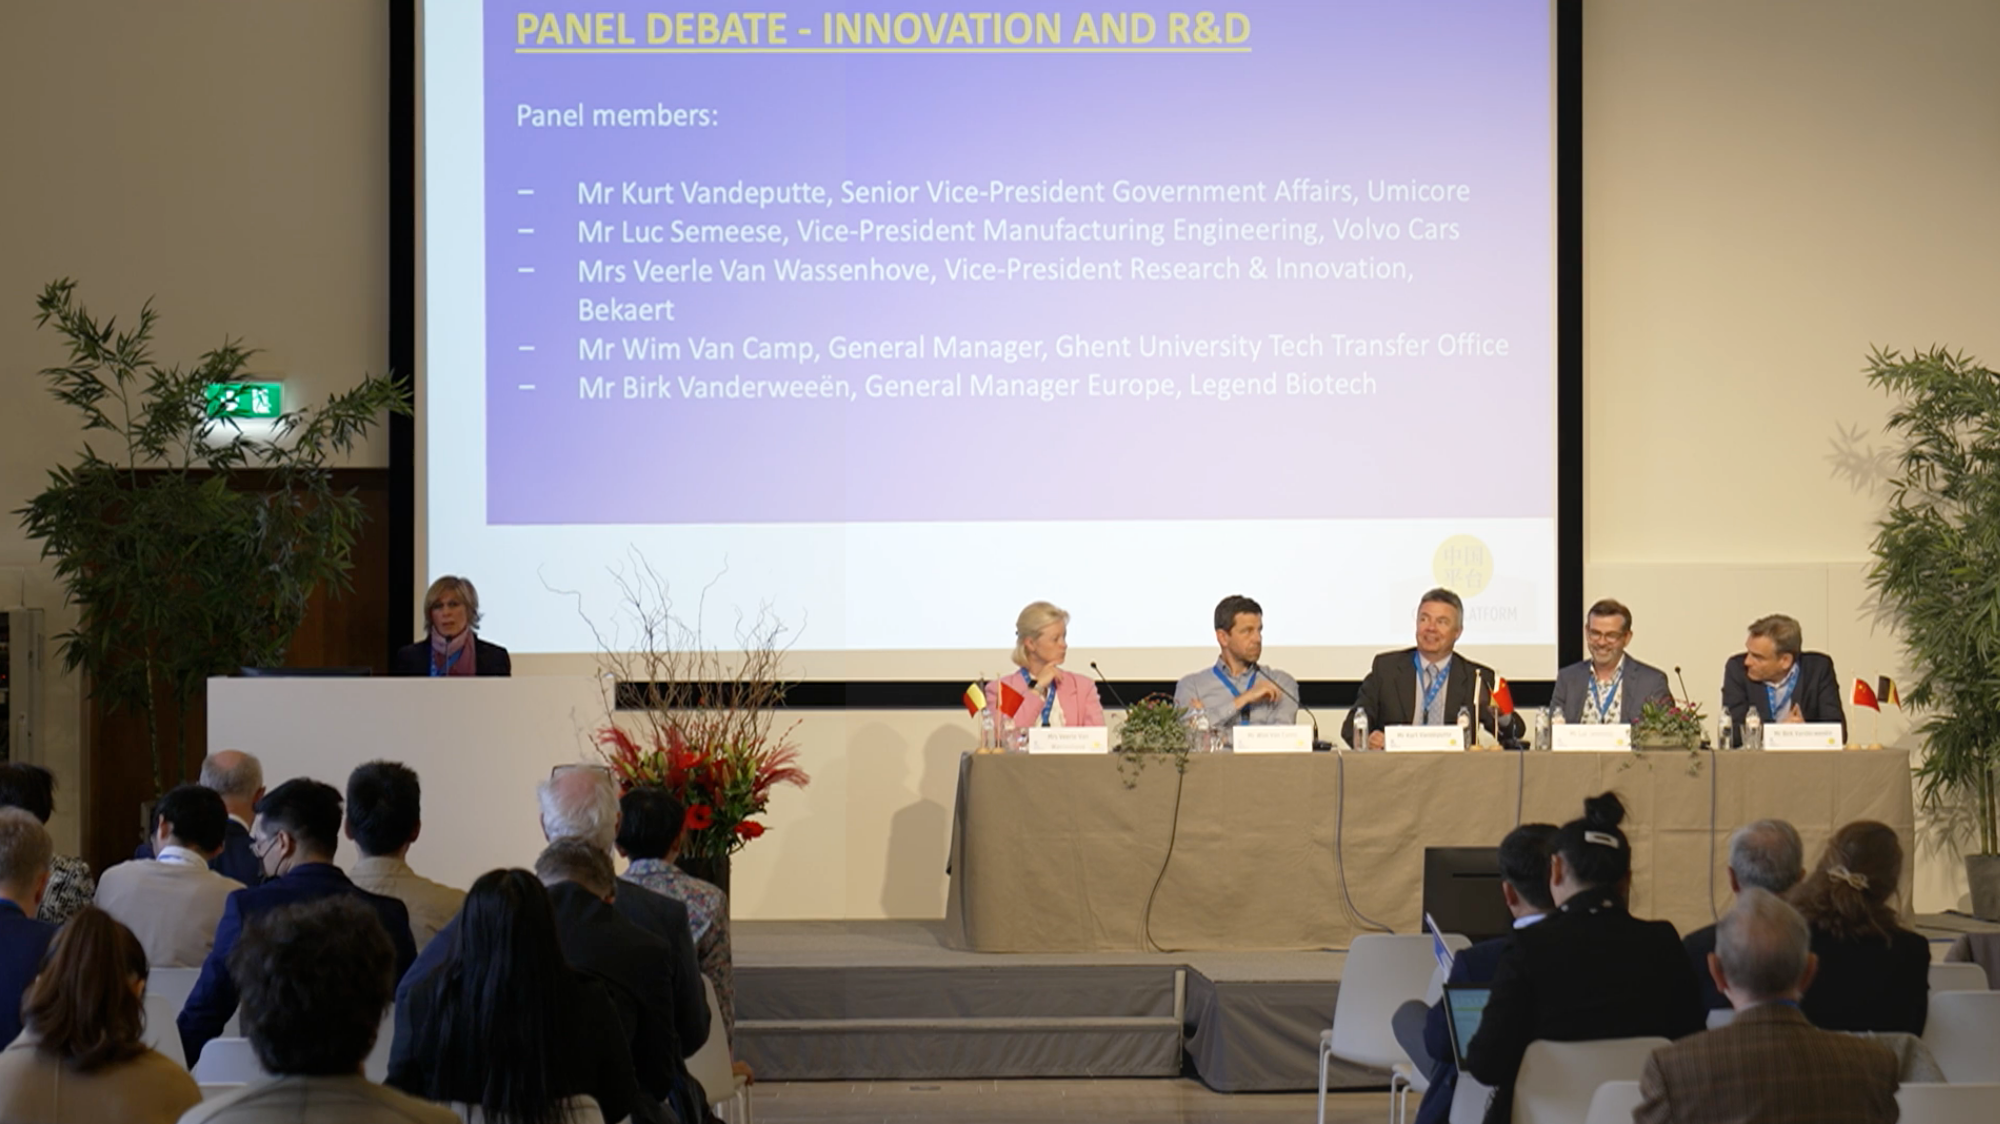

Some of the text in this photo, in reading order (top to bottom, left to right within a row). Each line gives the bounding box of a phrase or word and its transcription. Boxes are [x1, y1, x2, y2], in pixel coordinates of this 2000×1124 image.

[518, 13, 635, 45] PANEL
[647, 12, 787, 44] DEBATE
[824, 12, 1061, 44] INNOVATION
[1073, 12, 1156, 44] AND
[1169, 11, 1250, 44] R&D
[518, 102, 717, 127] Panel members:
[579, 178, 1470, 209] Mr Kurt Vandeputte, Senior Vice-President Government Affairs, Umicore
[579, 216, 1459, 246] Mr Luc Semeese, Vice-President Manufacturing Engineering, Volvo Cars
[579, 255, 1413, 284] Mrs Veerle Van Wassenhove, Vice-President Research & Innovation,
[579, 297, 675, 321] Bekaert
[580, 332, 1508, 364] Mr Wim Van Camp, General Manager, Ghent University Tech Transfer Office
[580, 371, 1376, 401] Mr Birk Vanderweeën, General Manager Europe, Legend Biotech
[1444, 545, 1484, 567] 中国
[1444, 567, 1484, 589] 平台
[1464, 606, 1517, 621] ATFORM
